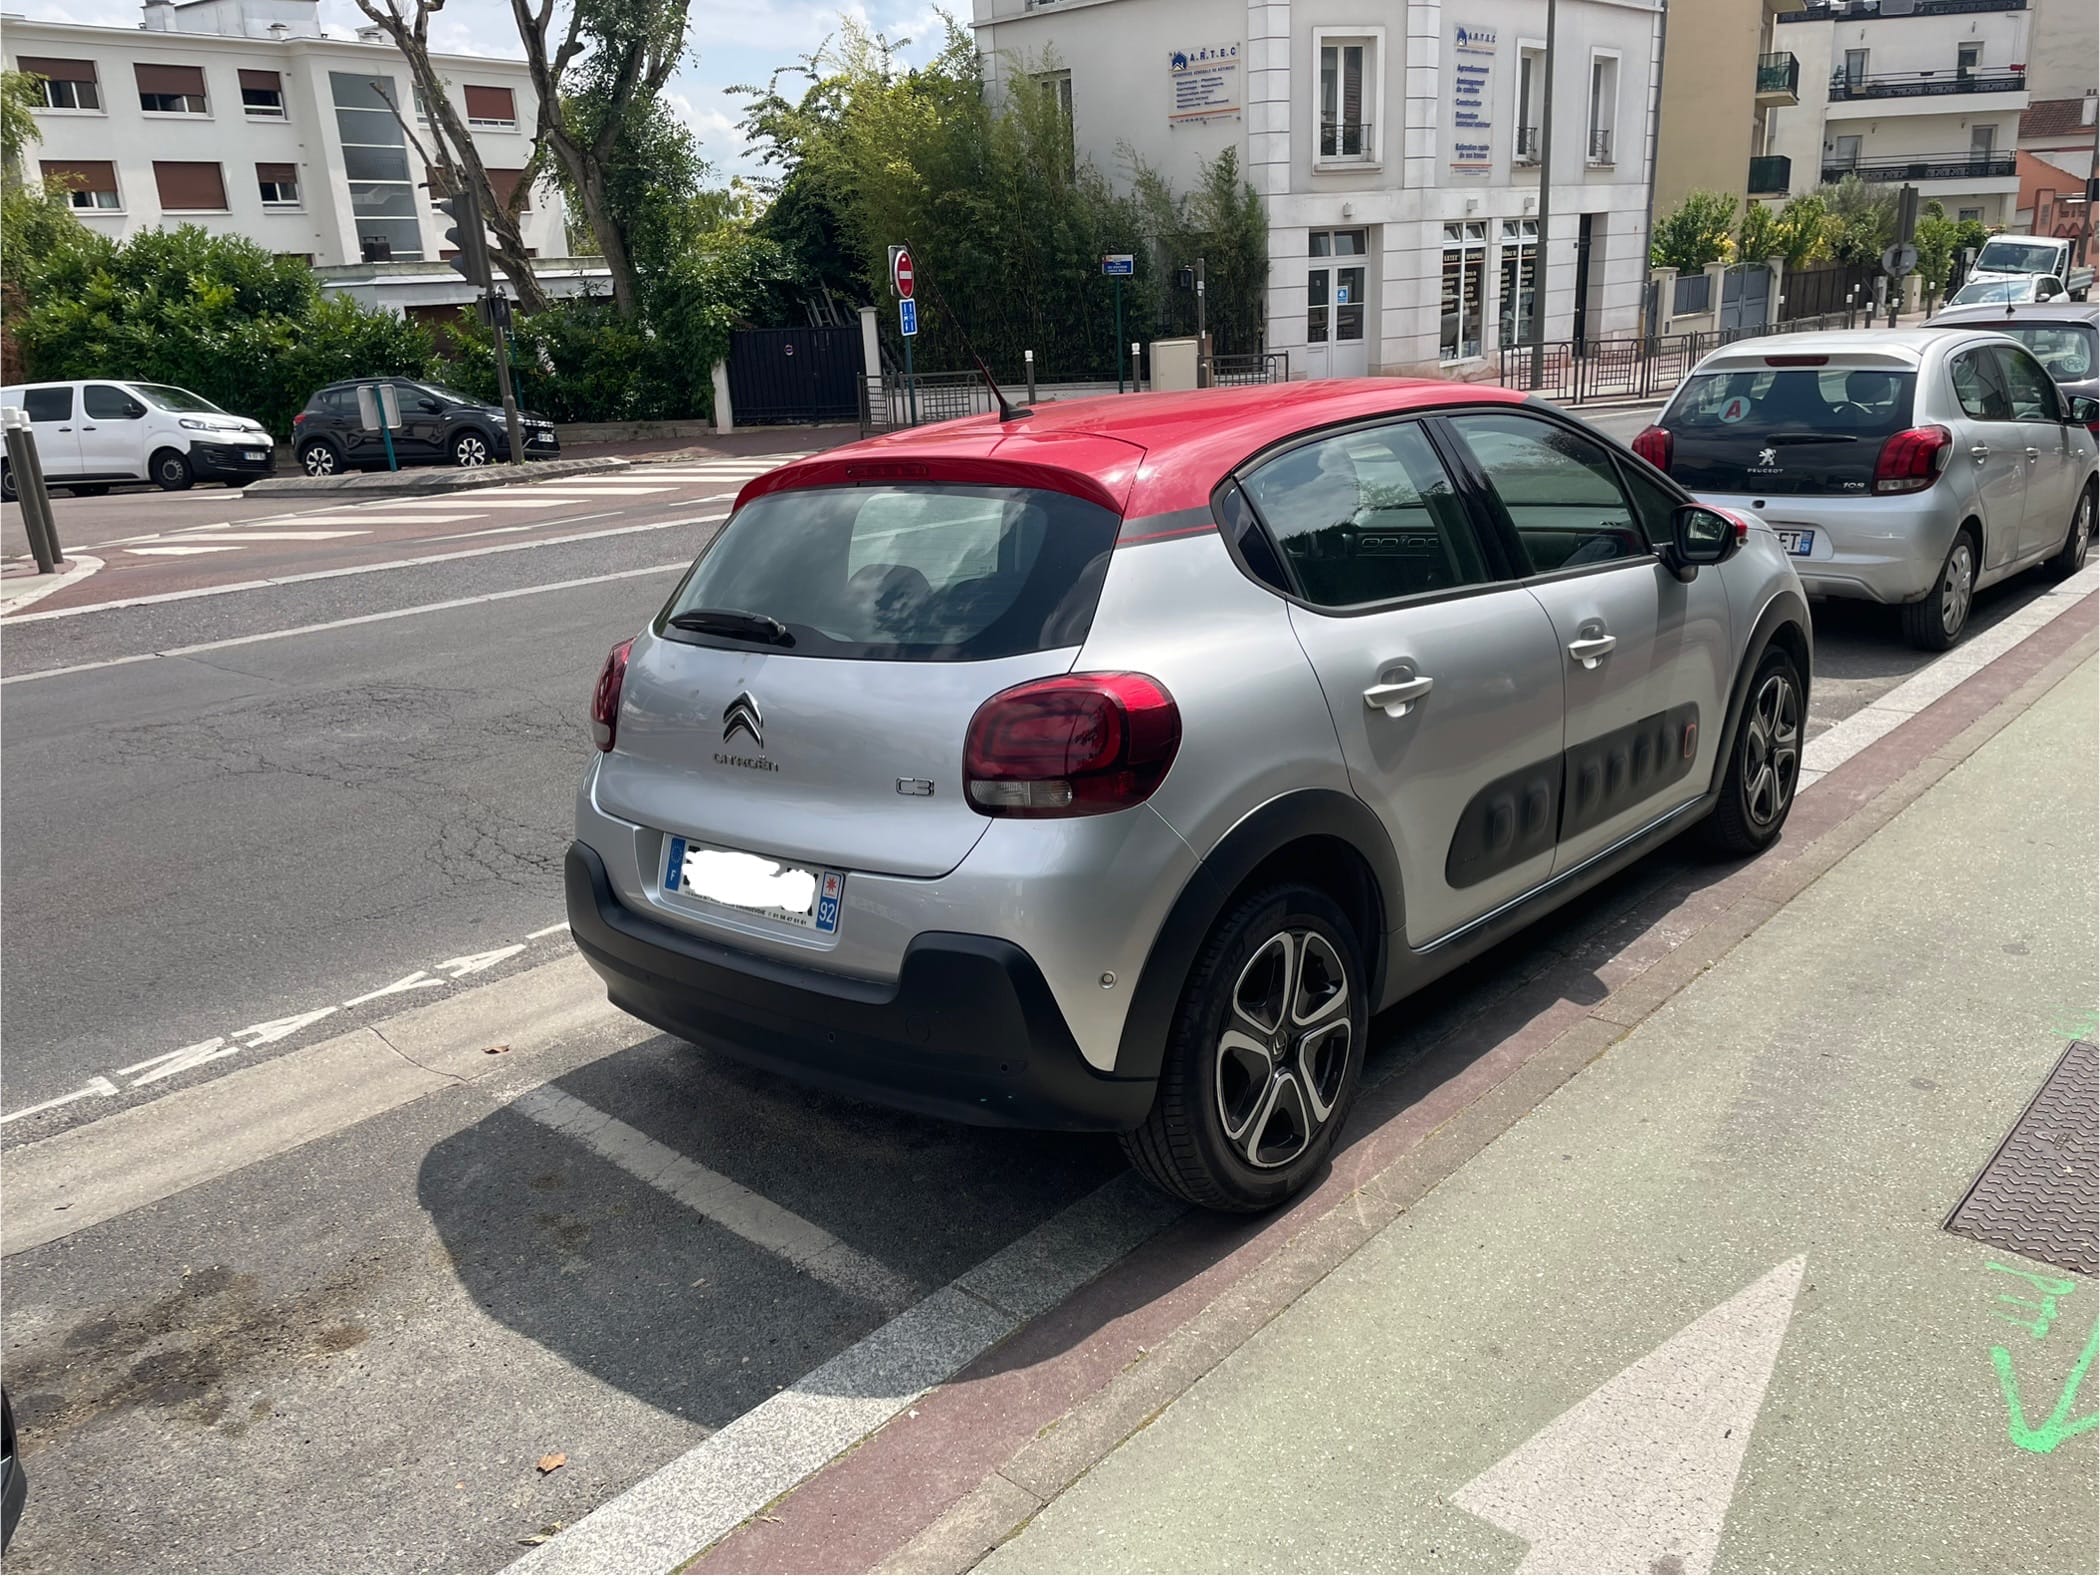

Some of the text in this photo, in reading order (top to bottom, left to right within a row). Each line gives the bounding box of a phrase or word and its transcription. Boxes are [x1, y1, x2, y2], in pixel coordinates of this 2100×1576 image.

[1190, 47, 1236, 62] A.R.T.E.C
[1724, 400, 1742, 419] A
[896, 776, 935, 797] C3
[670, 869, 676, 882] F
[818, 902, 835, 924] 92
